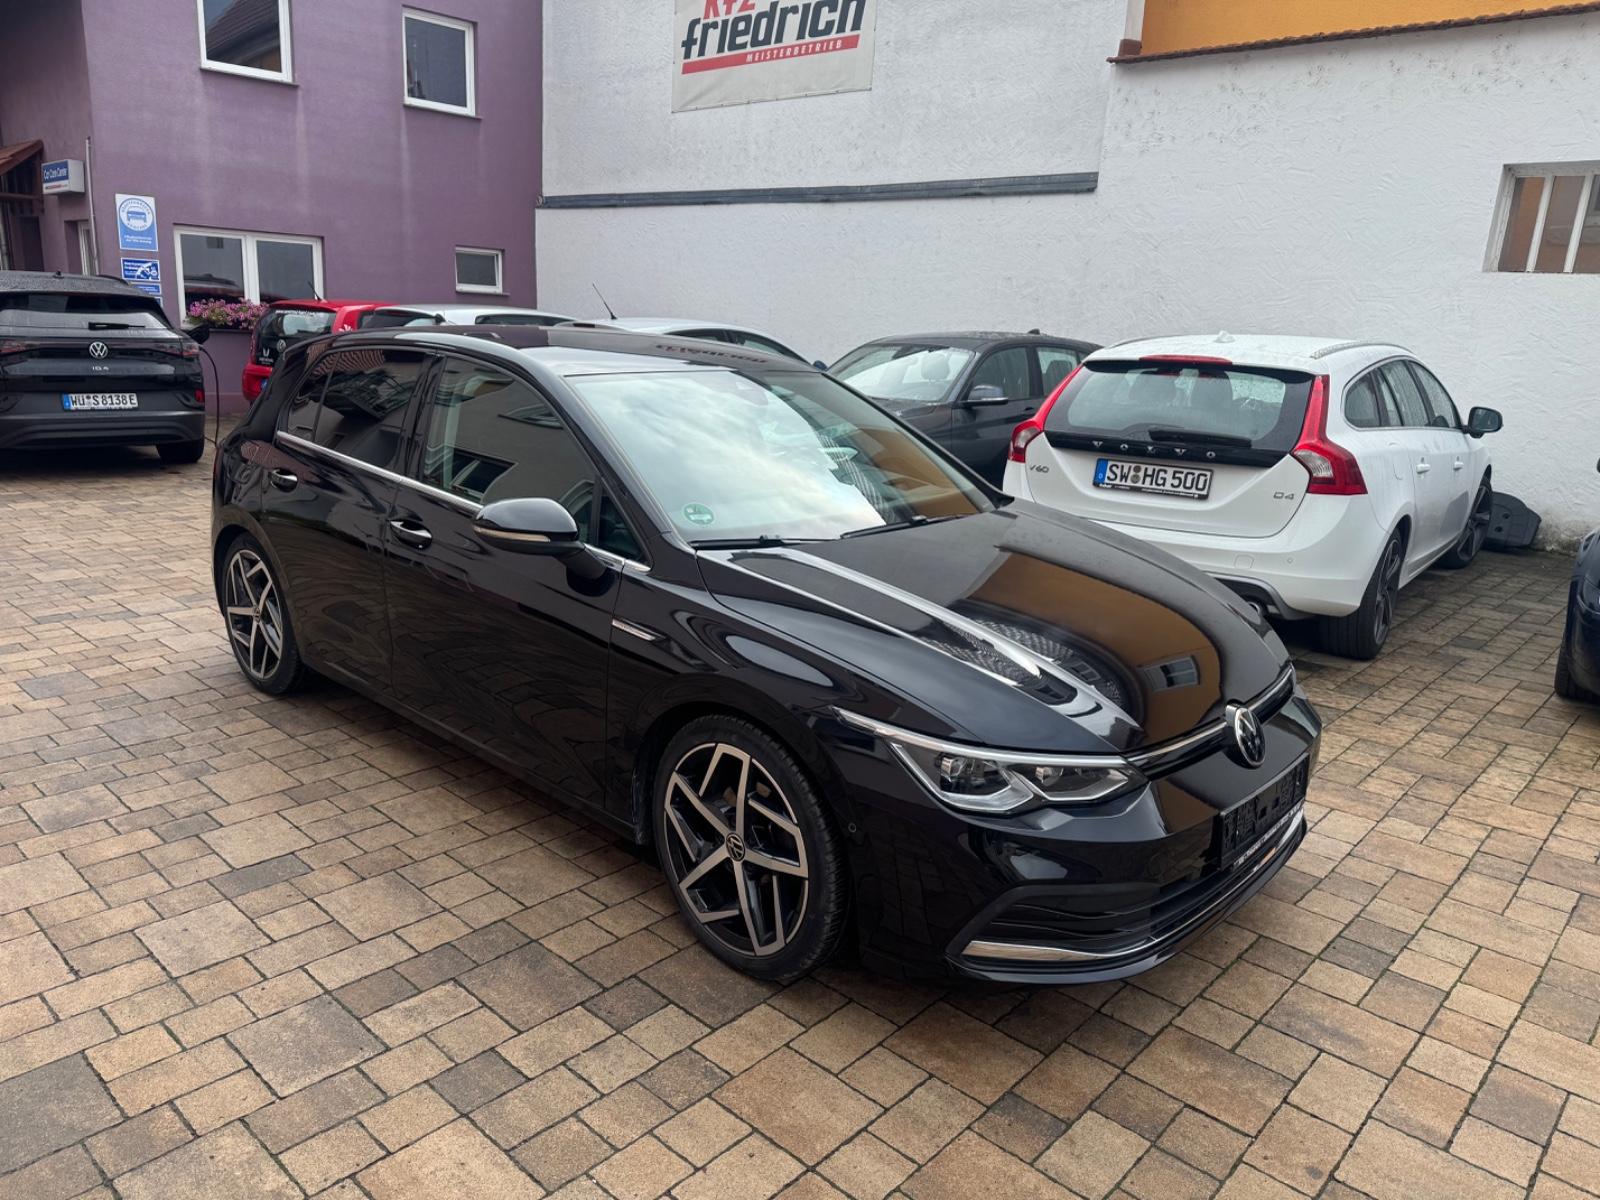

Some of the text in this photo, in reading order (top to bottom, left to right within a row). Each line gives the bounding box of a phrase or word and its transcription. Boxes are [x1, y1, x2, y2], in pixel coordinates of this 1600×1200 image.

[681, 0, 866, 60] friedrich
[745, 39, 842, 63] MEISTERBETRIEB
[1106, 463, 1208, 491] SW HG 500
[1273, 491, 1295, 500] D4
